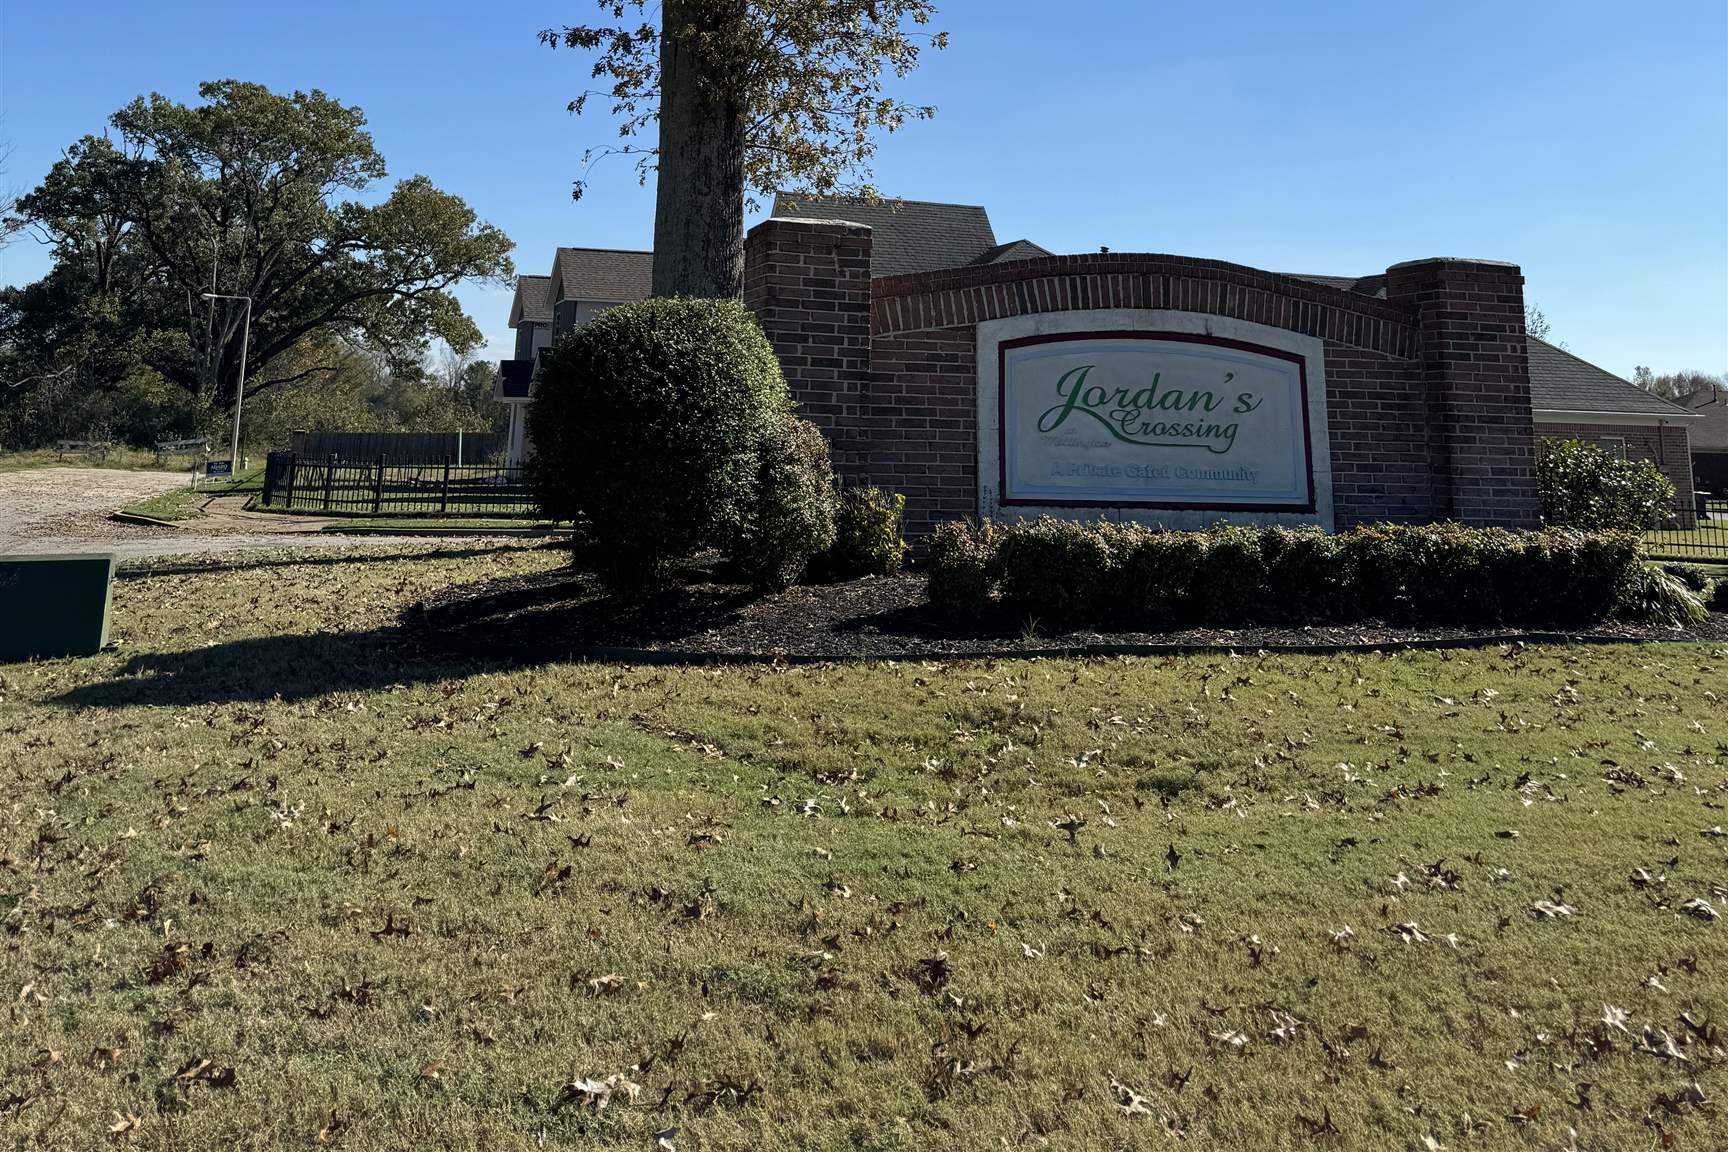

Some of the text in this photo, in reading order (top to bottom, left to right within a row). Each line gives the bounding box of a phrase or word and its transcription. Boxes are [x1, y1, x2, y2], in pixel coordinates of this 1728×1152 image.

[1038, 365, 1263, 433] Jordan's
[1110, 408, 1238, 454] Crossing
[1176, 465, 1258, 485] Community
